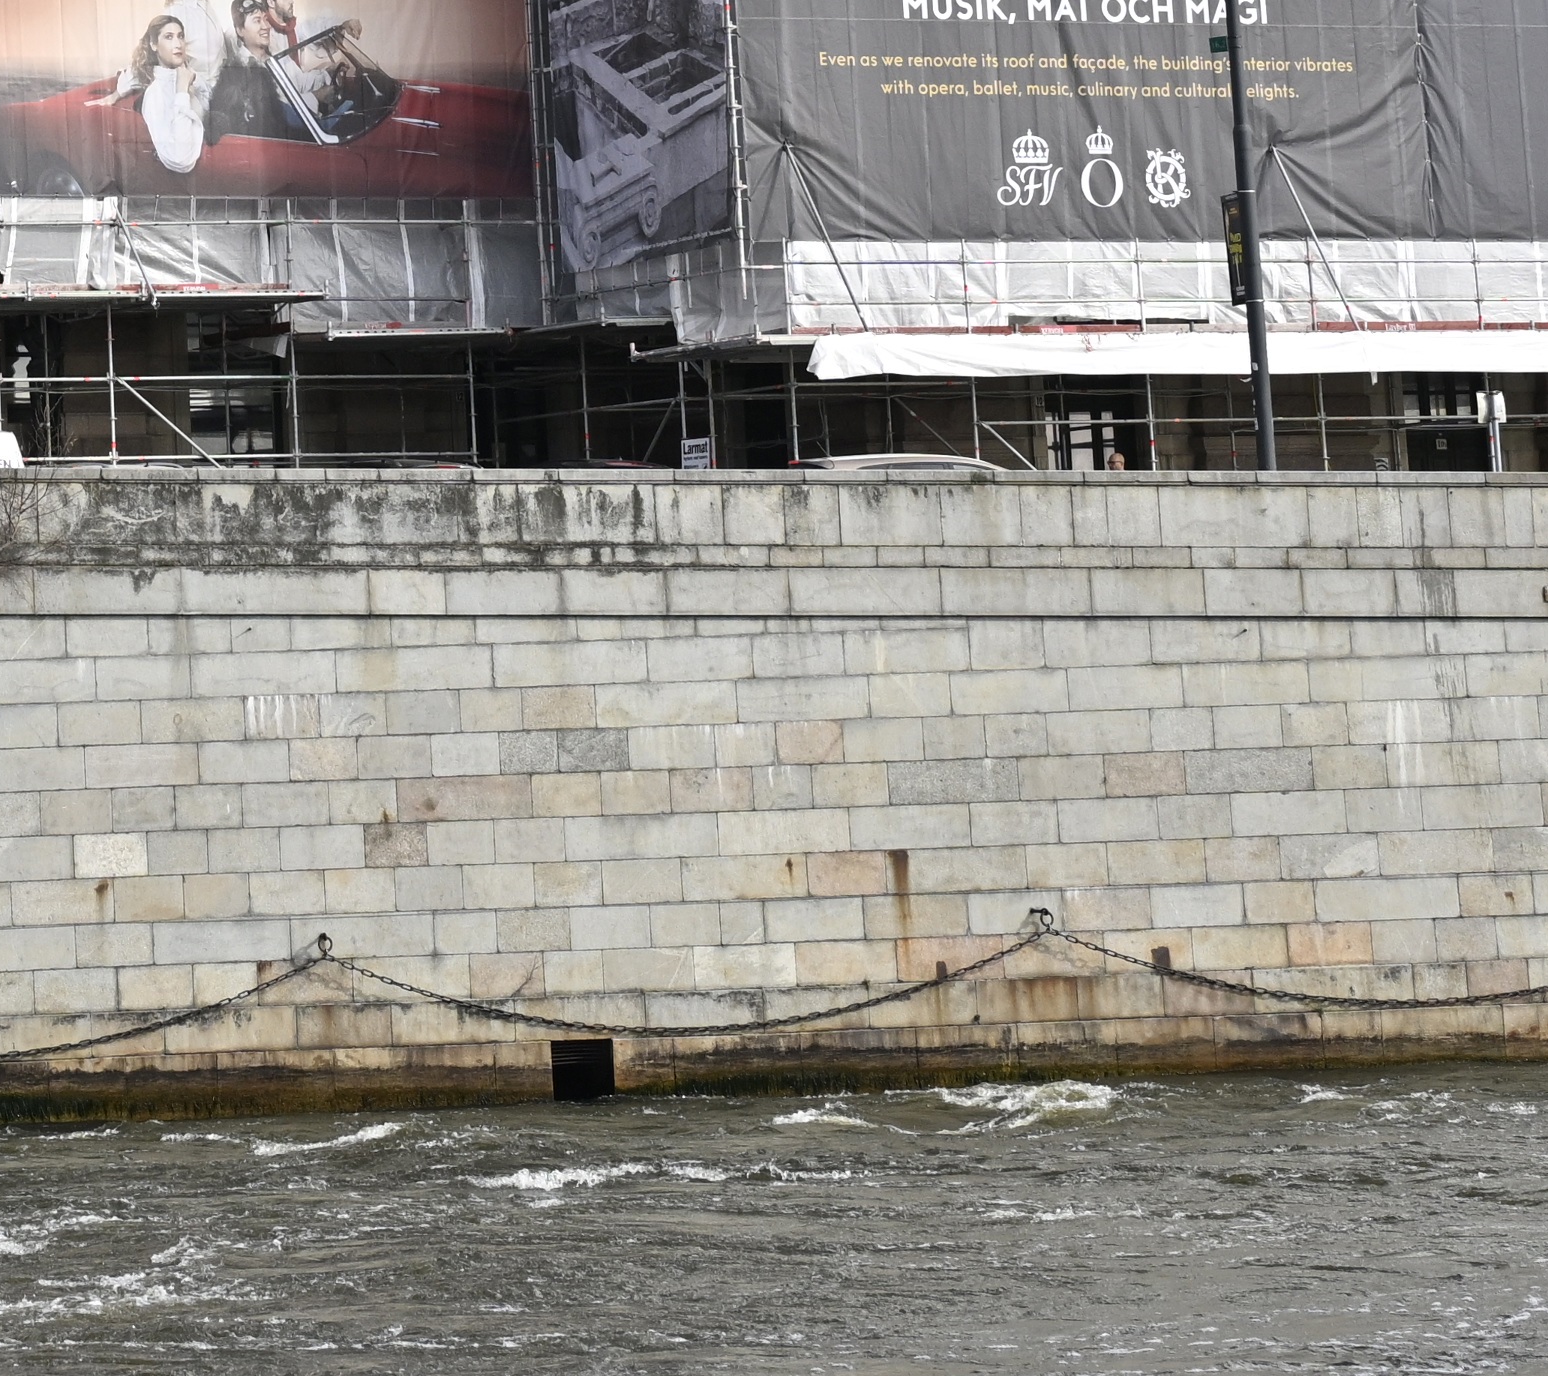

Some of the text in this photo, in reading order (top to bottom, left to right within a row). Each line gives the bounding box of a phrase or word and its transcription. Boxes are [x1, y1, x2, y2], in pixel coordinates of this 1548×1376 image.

[819, 52, 855, 67] Even
[860, 55, 878, 67] as
[881, 56, 904, 67] we
[908, 54, 978, 68] renovate
[981, 54, 999, 68] its
[1004, 53, 1035, 69] roof
[1038, 55, 1068, 69] and
[1072, 54, 1129, 73] façade,
[1133, 56, 1158, 71] the
[1243, 58, 1291, 72] nterior
[1294, 58, 1353, 73] vibrates
[880, 80, 1300, 101] with opera, ballet, music, culinary and cultural elights.
[683, 441, 708, 455] Larmat
